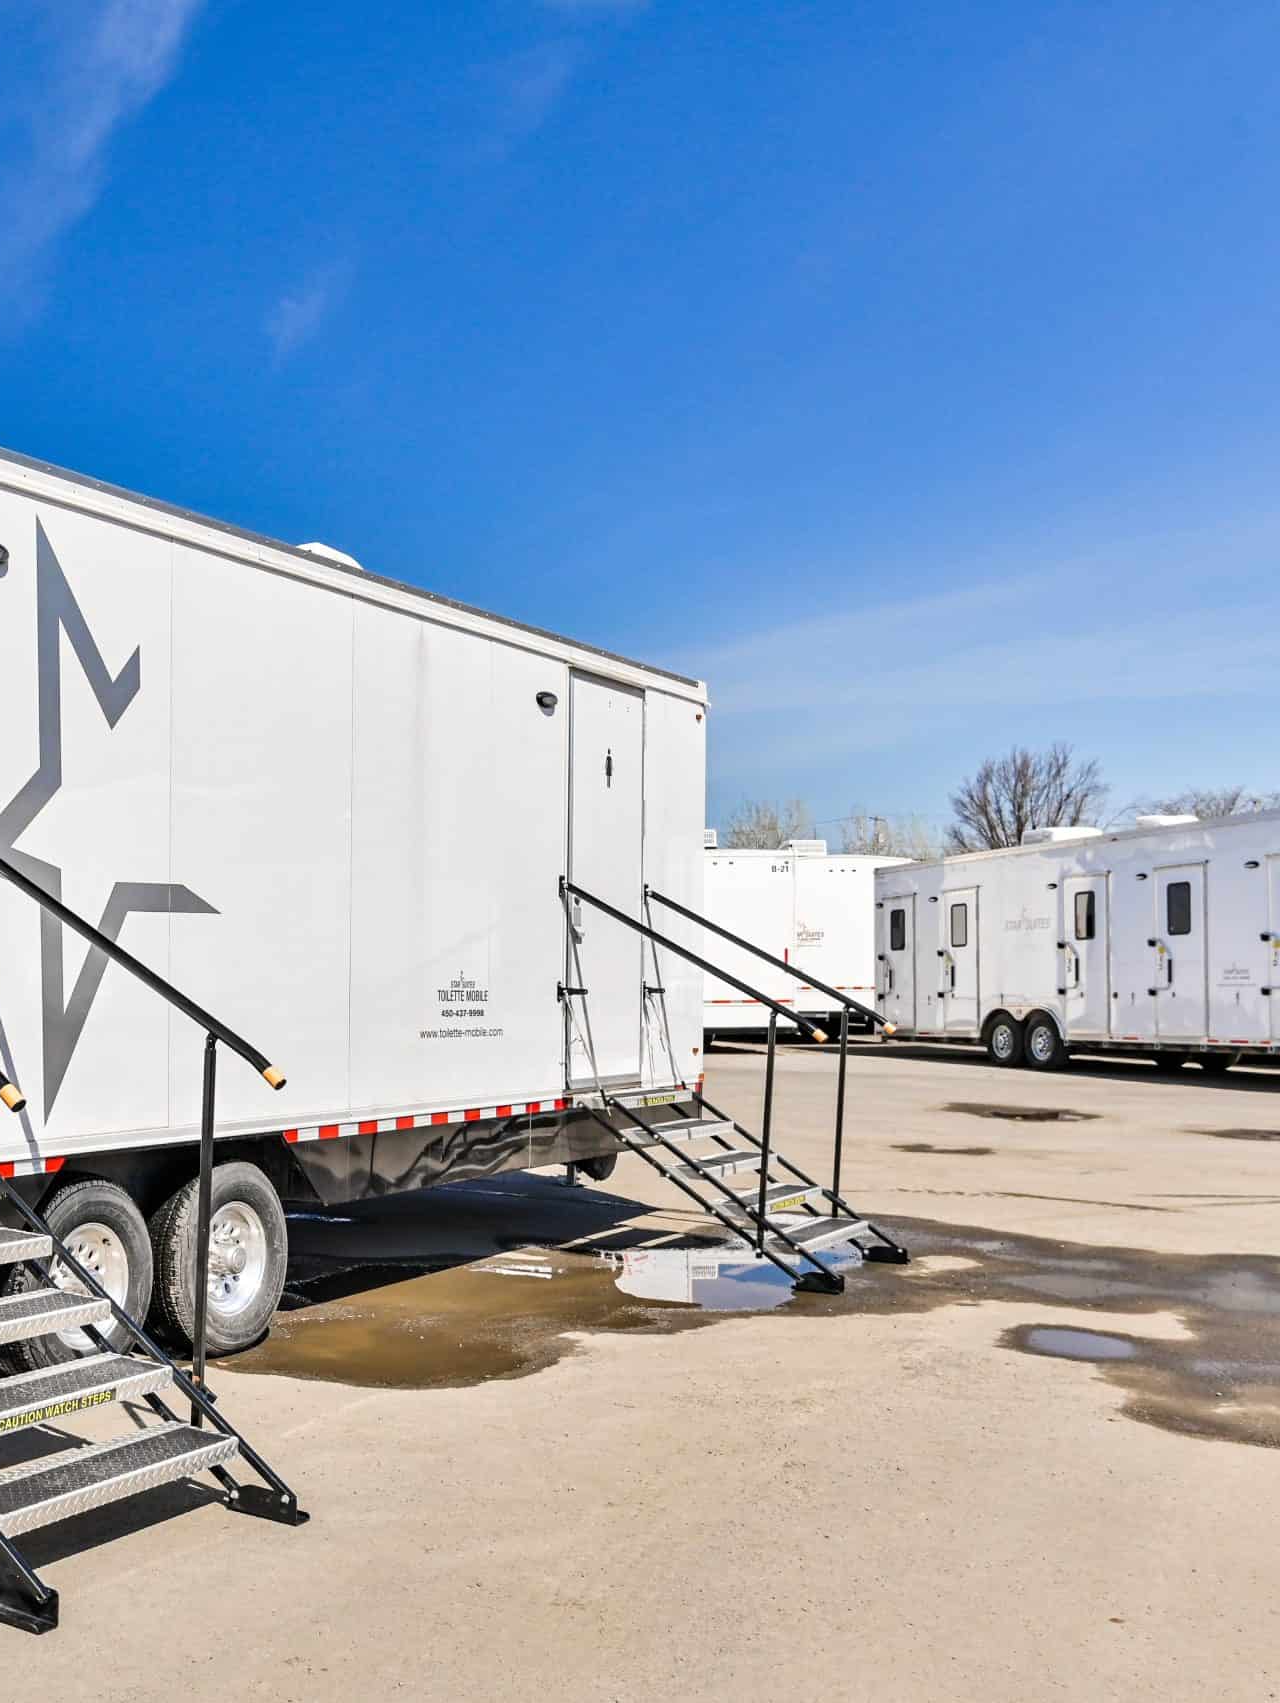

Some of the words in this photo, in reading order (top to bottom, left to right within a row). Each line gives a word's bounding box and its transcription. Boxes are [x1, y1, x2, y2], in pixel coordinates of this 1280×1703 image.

[437, 989, 465, 1001] TOILETTE
[466, 989, 488, 1001] MOBILE
[45, 1400, 79, 1417] WATCH
[81, 1391, 112, 1408] STEPS
